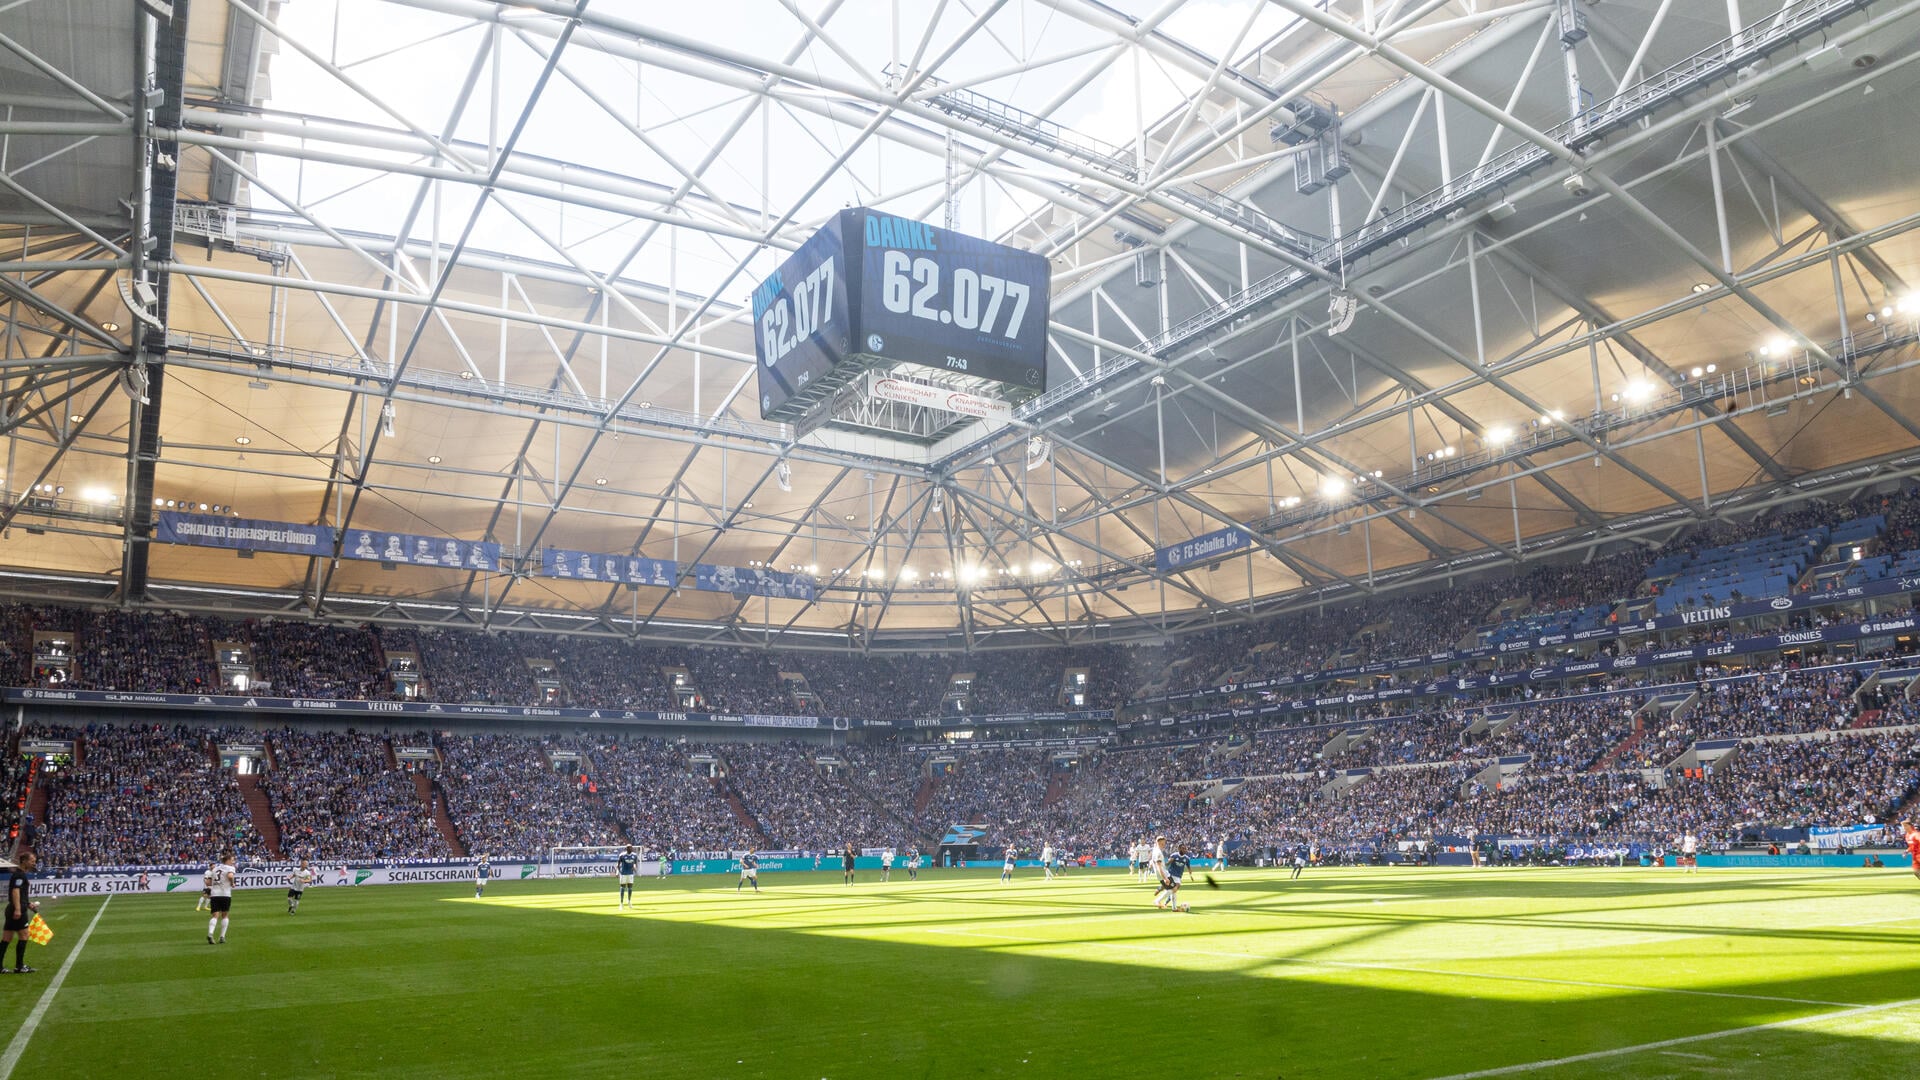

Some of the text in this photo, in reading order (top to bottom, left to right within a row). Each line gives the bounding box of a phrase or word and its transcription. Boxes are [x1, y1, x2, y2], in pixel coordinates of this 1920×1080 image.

[866, 215, 937, 250] DANKE
[752, 269, 784, 321] DANKE
[883, 250, 1030, 339] 62.077
[762, 255, 834, 368] 62.077
[946, 356, 967, 370] 77:43
[883, 383, 937, 398] KNAPPSCHAFT
[883, 391, 918, 403] KLINIKEN
[955, 398, 1006, 412] KNAPPSCHAFT
[955, 405, 987, 416] KLINIKEN
[176, 522, 317, 545] SCHALKER EHRENSPIELFÜHRER
[1184, 531, 1238, 559] FC Schalke 04
[1681, 606, 1731, 624] VELTINS
[1707, 647, 1723, 655] ELE
[368, 702, 403, 711] VELTINS
[1320, 696, 1344, 705] GEBERIT
[657, 712, 687, 720] VELTINS
[914, 719, 940, 727] VELTINS
[559, 864, 617, 874] VERMESSUN
[760, 861, 783, 870] stellen
[214, 869, 223, 881] 3
[30, 881, 87, 895] HITEKTUR
[91, 881, 102, 892] &
